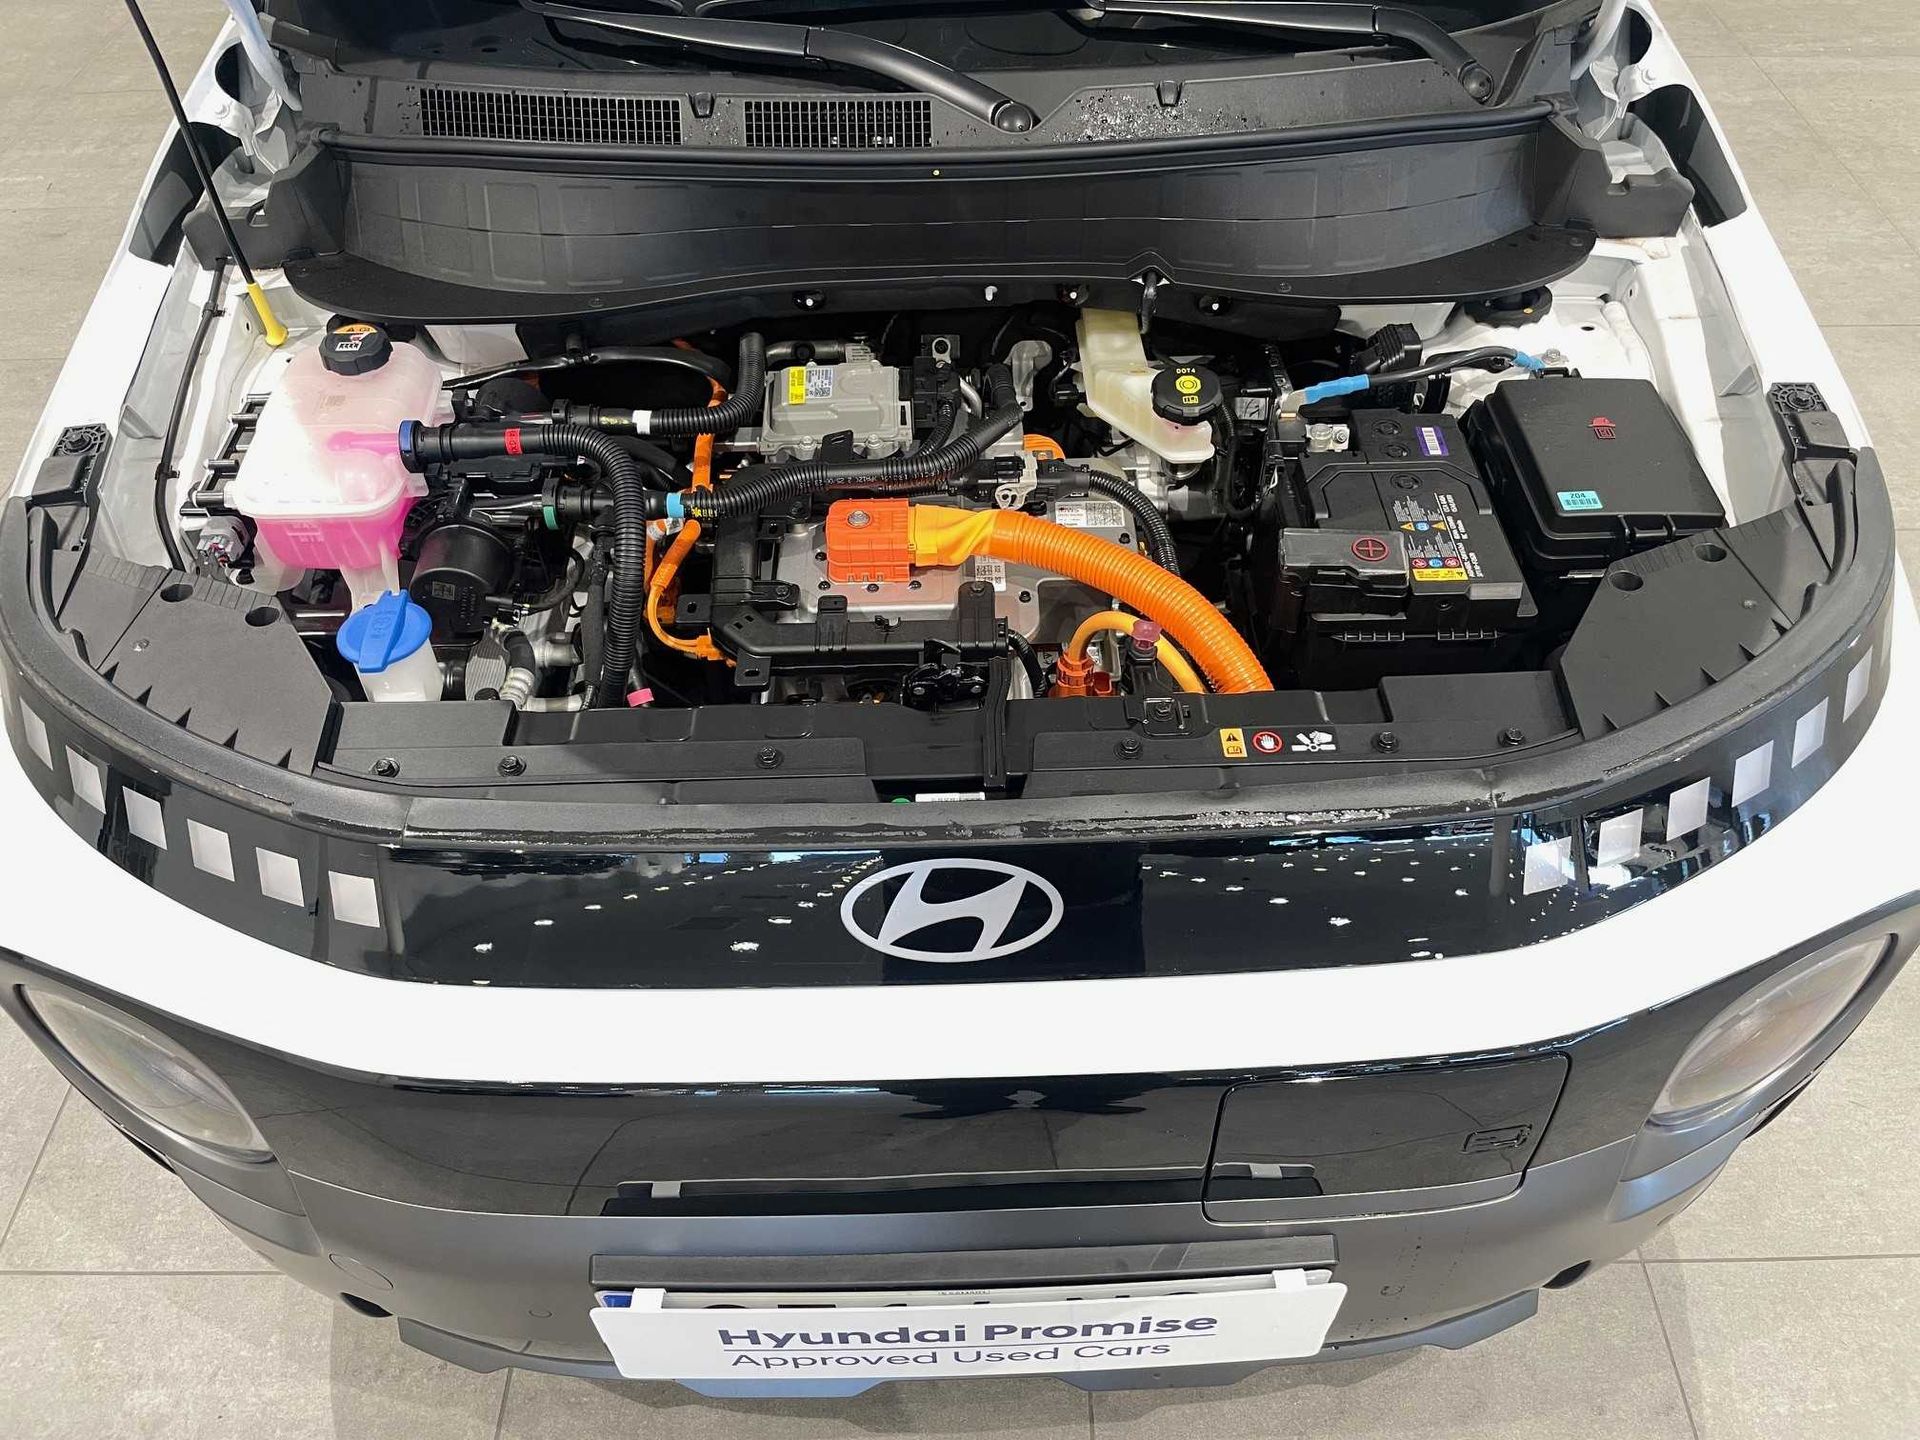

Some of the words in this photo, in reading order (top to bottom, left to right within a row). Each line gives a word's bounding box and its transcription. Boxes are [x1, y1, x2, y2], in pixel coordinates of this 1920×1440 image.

[718, 1324, 966, 1349] Hyundai
[984, 1316, 1218, 1341] Promise
[731, 1351, 938, 1369] Approved
[953, 1346, 1059, 1363] Used
[1073, 1345, 1171, 1359] Cars
